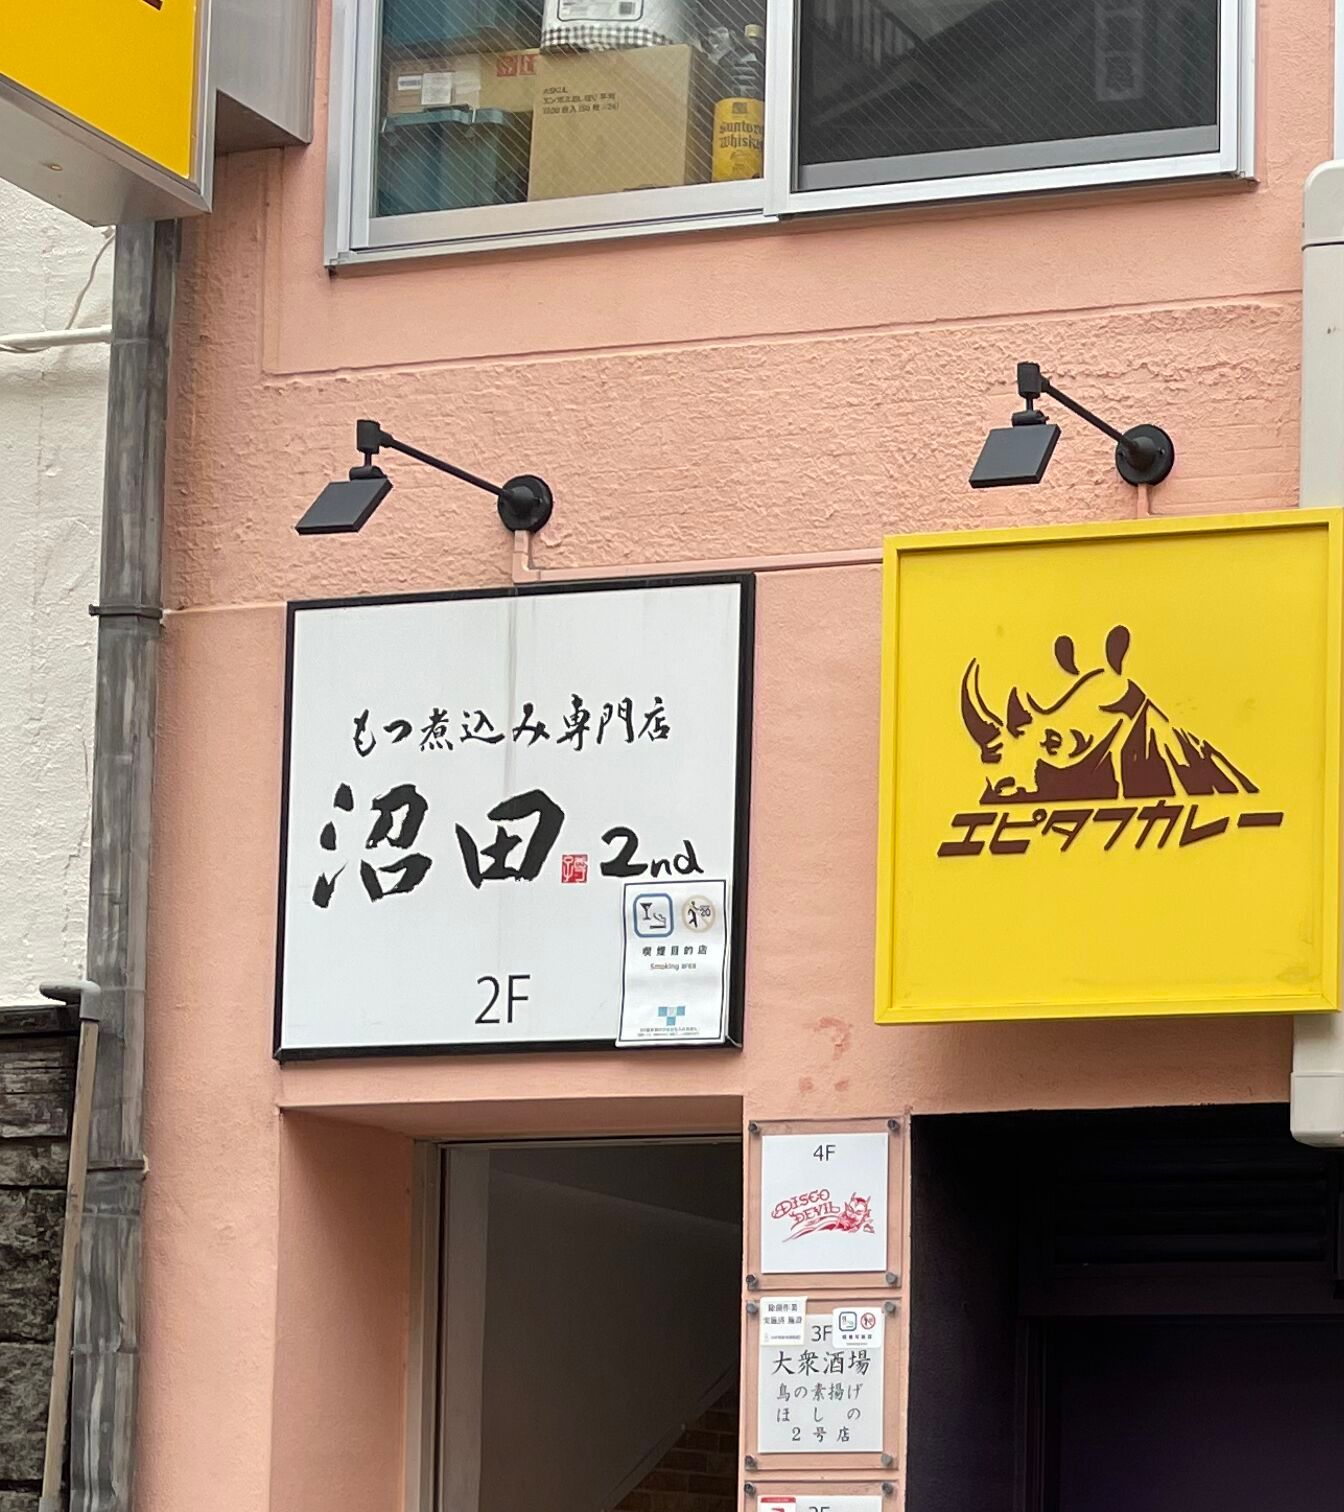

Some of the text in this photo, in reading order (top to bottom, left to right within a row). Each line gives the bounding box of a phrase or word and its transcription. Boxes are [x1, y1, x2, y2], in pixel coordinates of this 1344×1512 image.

[352, 693, 671, 757] もつ煮込み専門店
[311, 782, 705, 909] 沼田 2nd
[936, 800, 1284, 858] エピタフカレー
[474, 974, 531, 1025] 2F
[812, 1144, 836, 1162] 4F
[810, 1325, 833, 1343] 3F
[771, 1349, 871, 1377] 大衆酒場
[791, 1425, 851, 1444] 2号店
